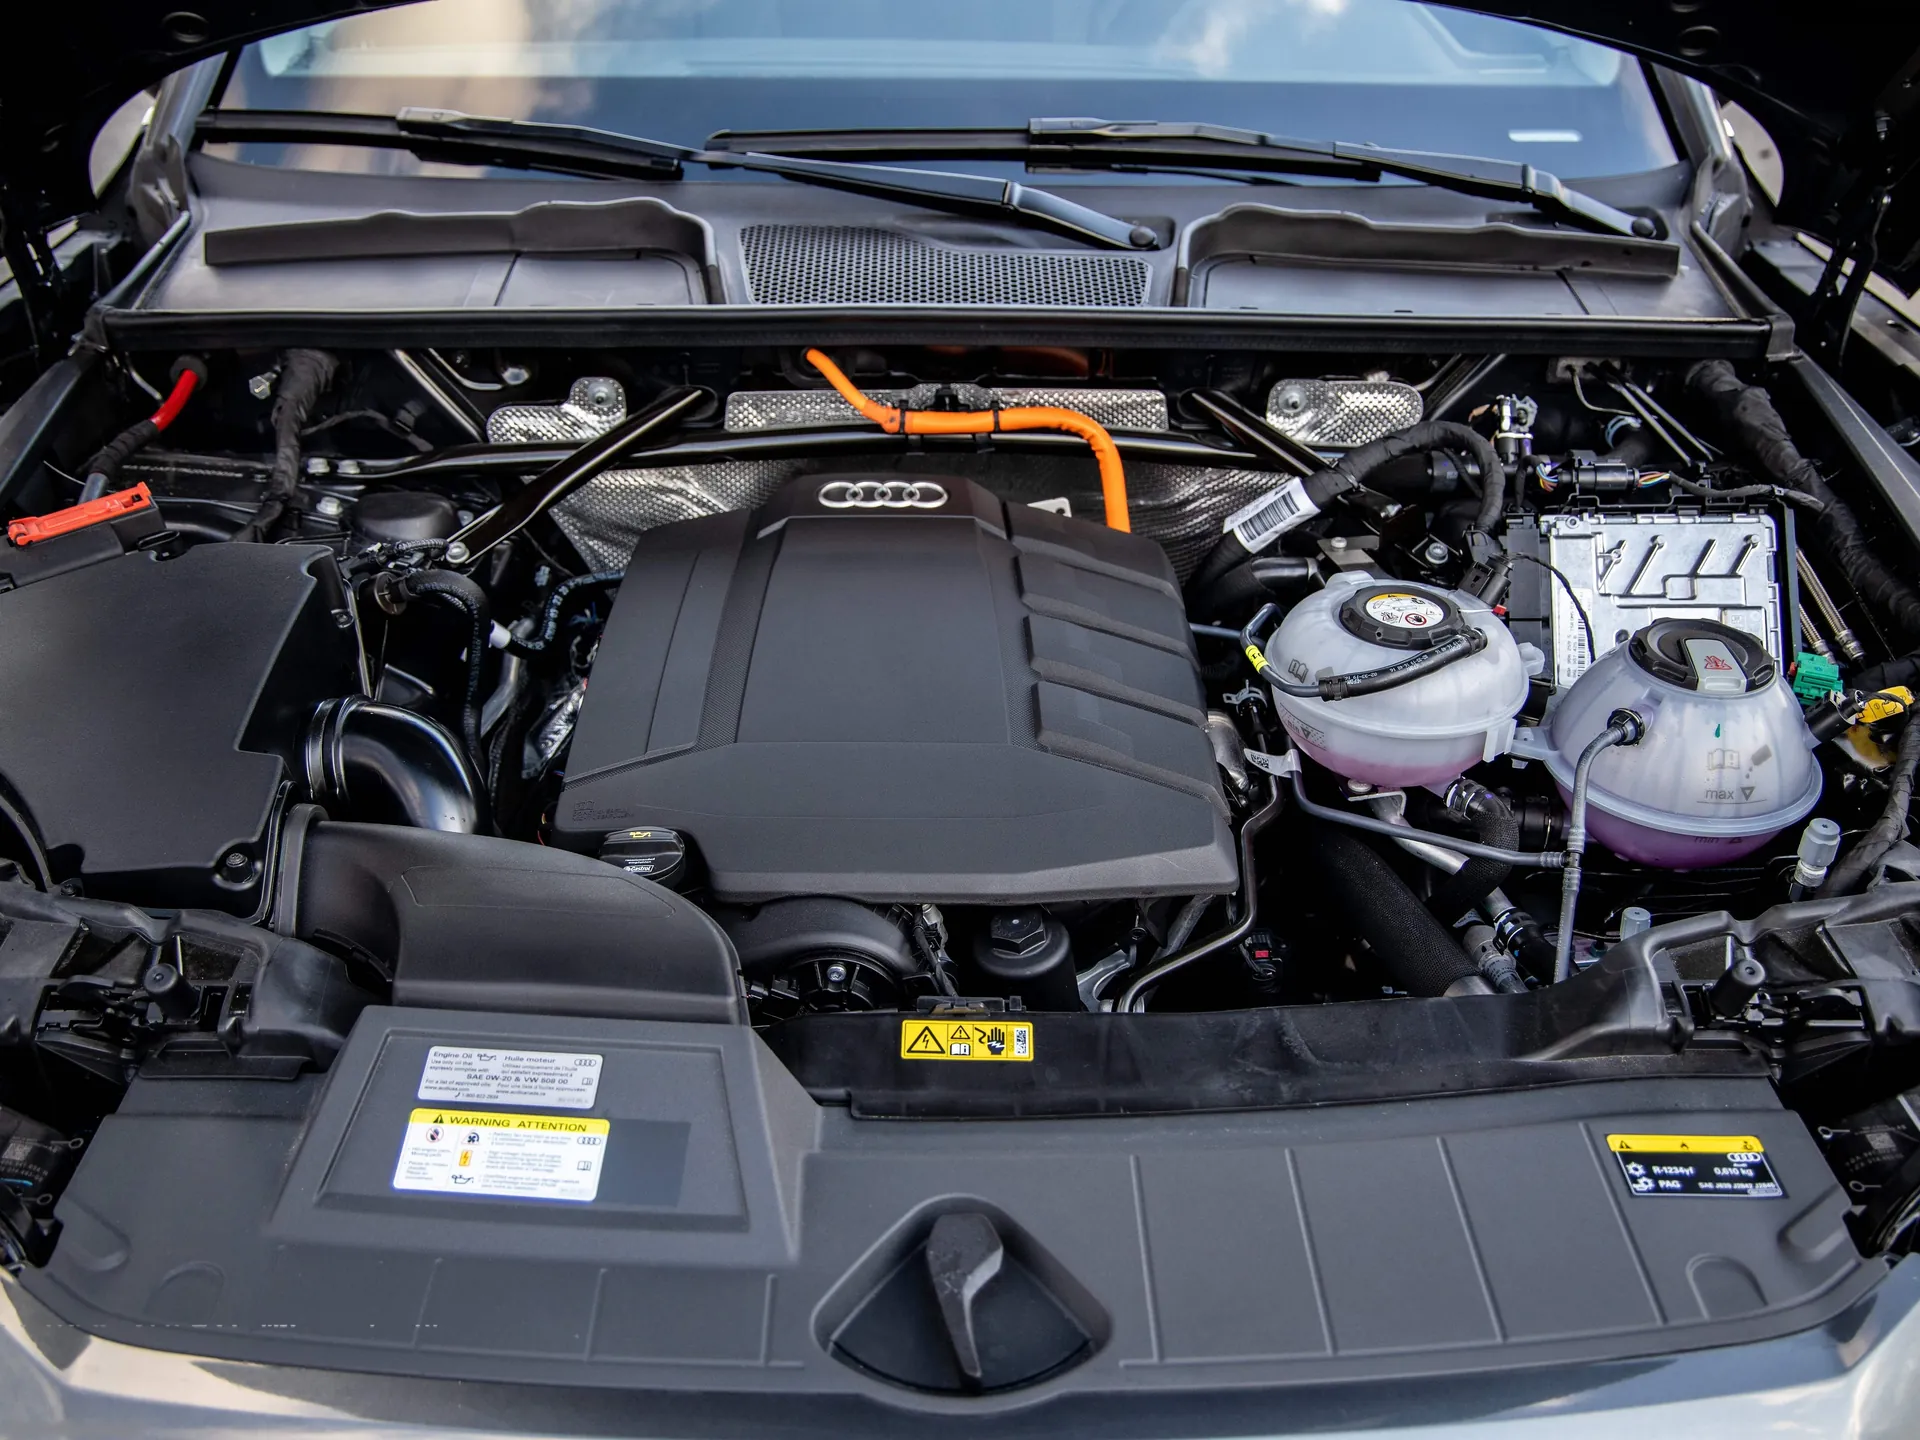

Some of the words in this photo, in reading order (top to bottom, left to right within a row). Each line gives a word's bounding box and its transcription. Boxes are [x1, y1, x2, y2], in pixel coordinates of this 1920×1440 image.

[1705, 789, 1734, 800] max
[434, 1051, 460, 1059] Engine
[450, 1116, 511, 1128] WARNING
[518, 1120, 587, 1132] ATTENTION
[1652, 1166, 1695, 1177] R-1234yf
[1740, 1168, 1754, 1177] kg
[1658, 1180, 1681, 1189] PAG
